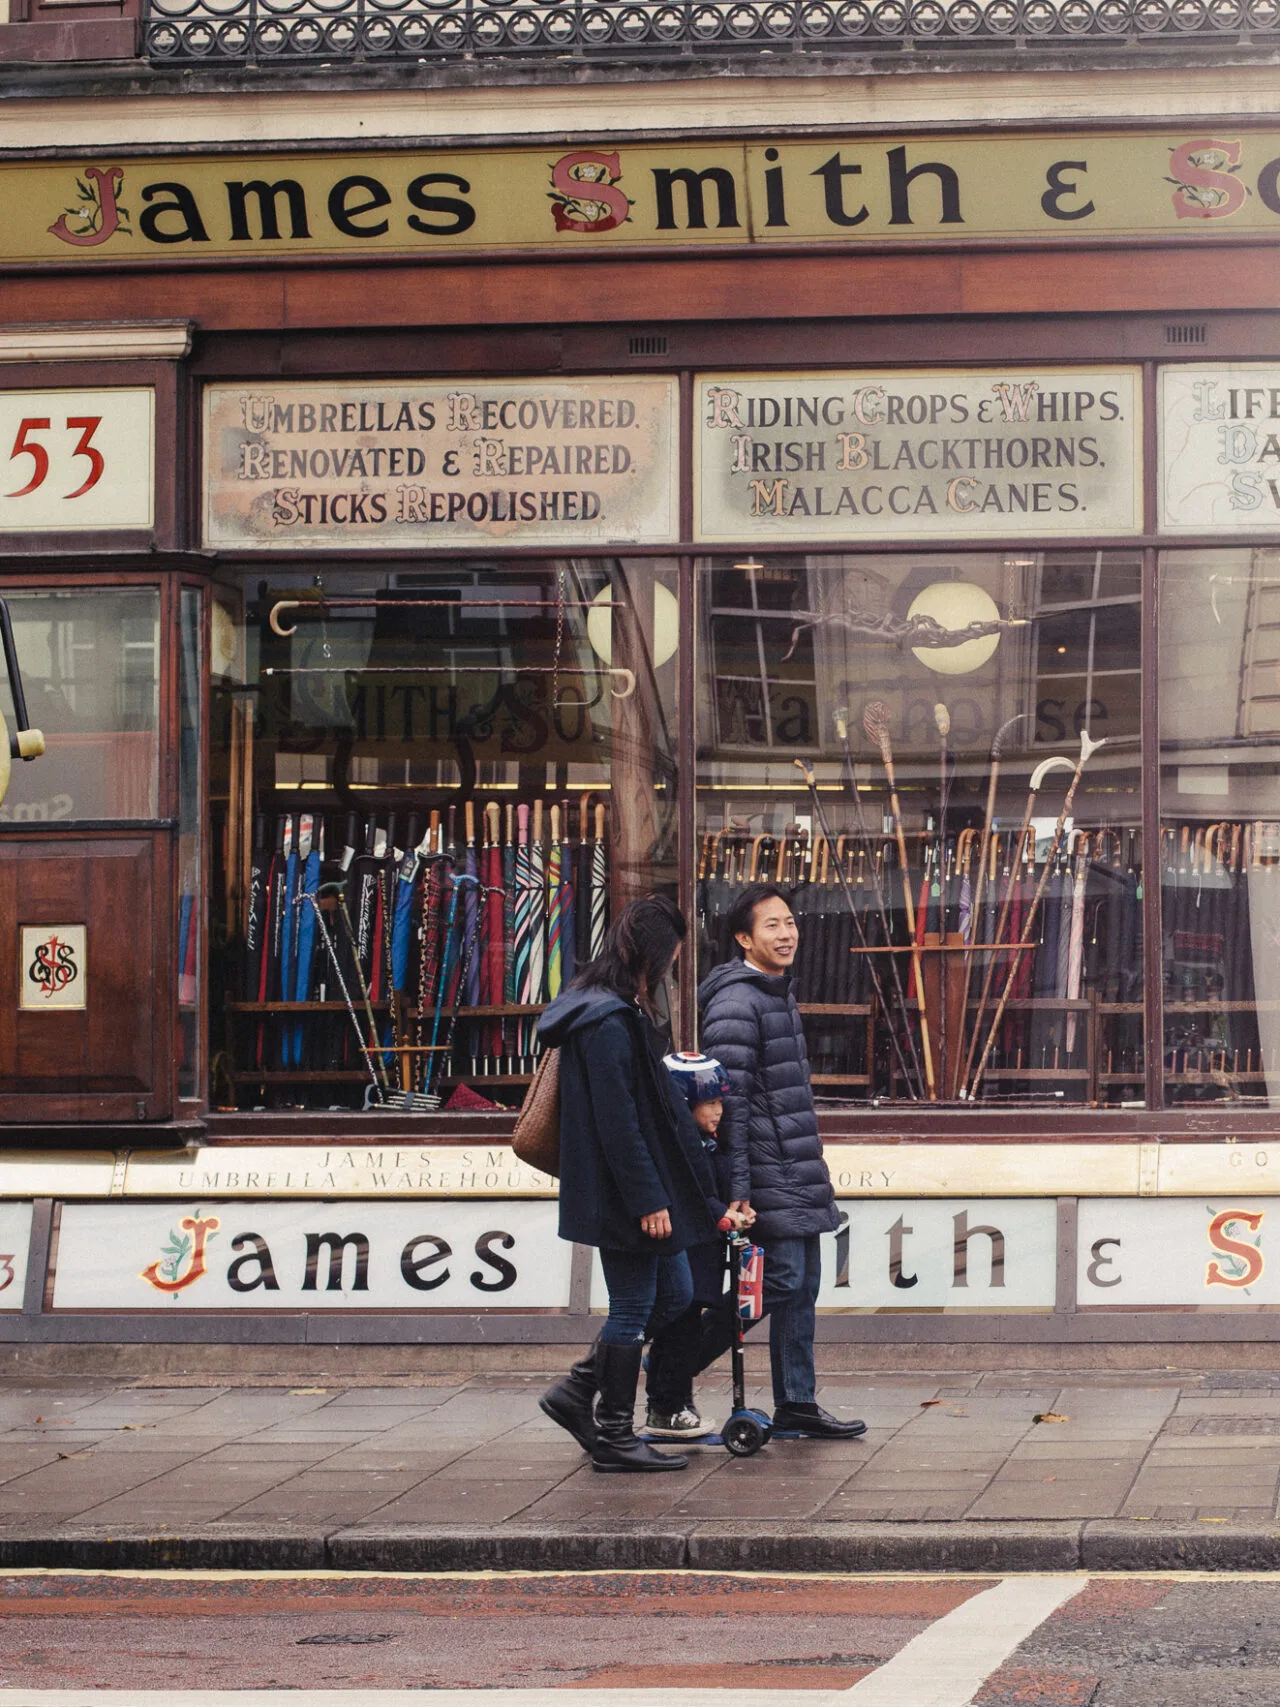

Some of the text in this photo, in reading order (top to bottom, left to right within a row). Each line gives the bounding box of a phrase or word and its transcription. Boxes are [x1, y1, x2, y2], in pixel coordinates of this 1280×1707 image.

[48, 166, 477, 246] James
[550, 145, 966, 234] Smith
[1040, 160, 1096, 221] &
[239, 392, 641, 435] UMBRELLAS RECOVERED.
[706, 380, 1126, 429] RIDING CROPS & WHIPS.
[3, 415, 105, 501] 53
[238, 437, 637, 481] RENOVATED & REPAIRED.
[730, 434, 827, 475] IRISH
[272, 484, 607, 527] STICKS REPOLISHED.
[749, 476, 1088, 518] MALACCA CANES.
[177, 1171, 337, 1189] UMBRELLA
[318, 1150, 432, 1168] JAMES
[138, 1215, 517, 1295] James
[830, 1208, 1006, 1289] ith
[1086, 1238, 1123, 1288] &
